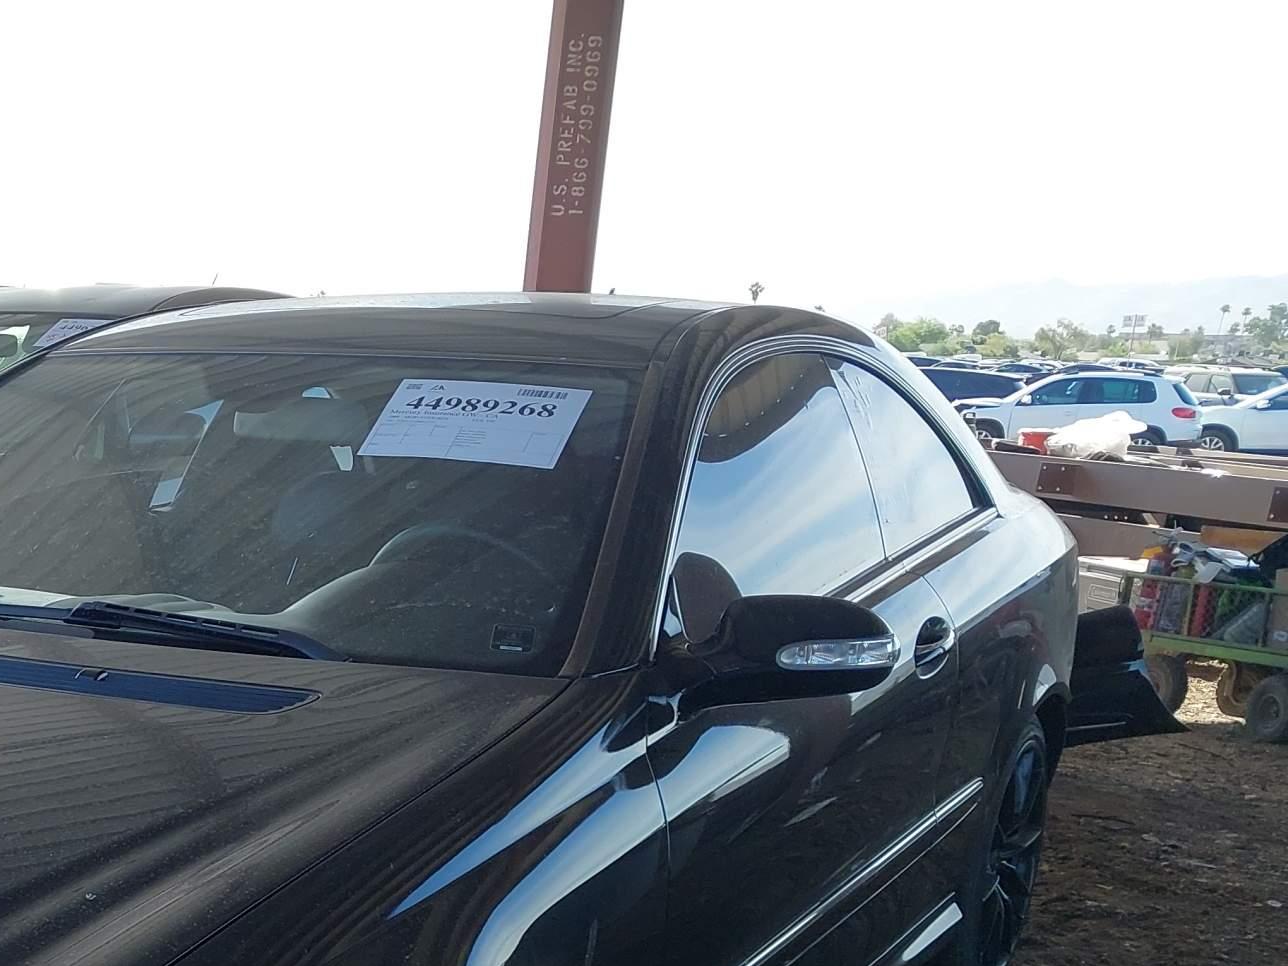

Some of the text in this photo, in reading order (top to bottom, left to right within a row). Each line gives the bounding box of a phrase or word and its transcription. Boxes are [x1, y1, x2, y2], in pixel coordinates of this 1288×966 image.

[551, 33, 586, 216] U.S. PREFAB INC.
[406, 395, 558, 419] 44989268
